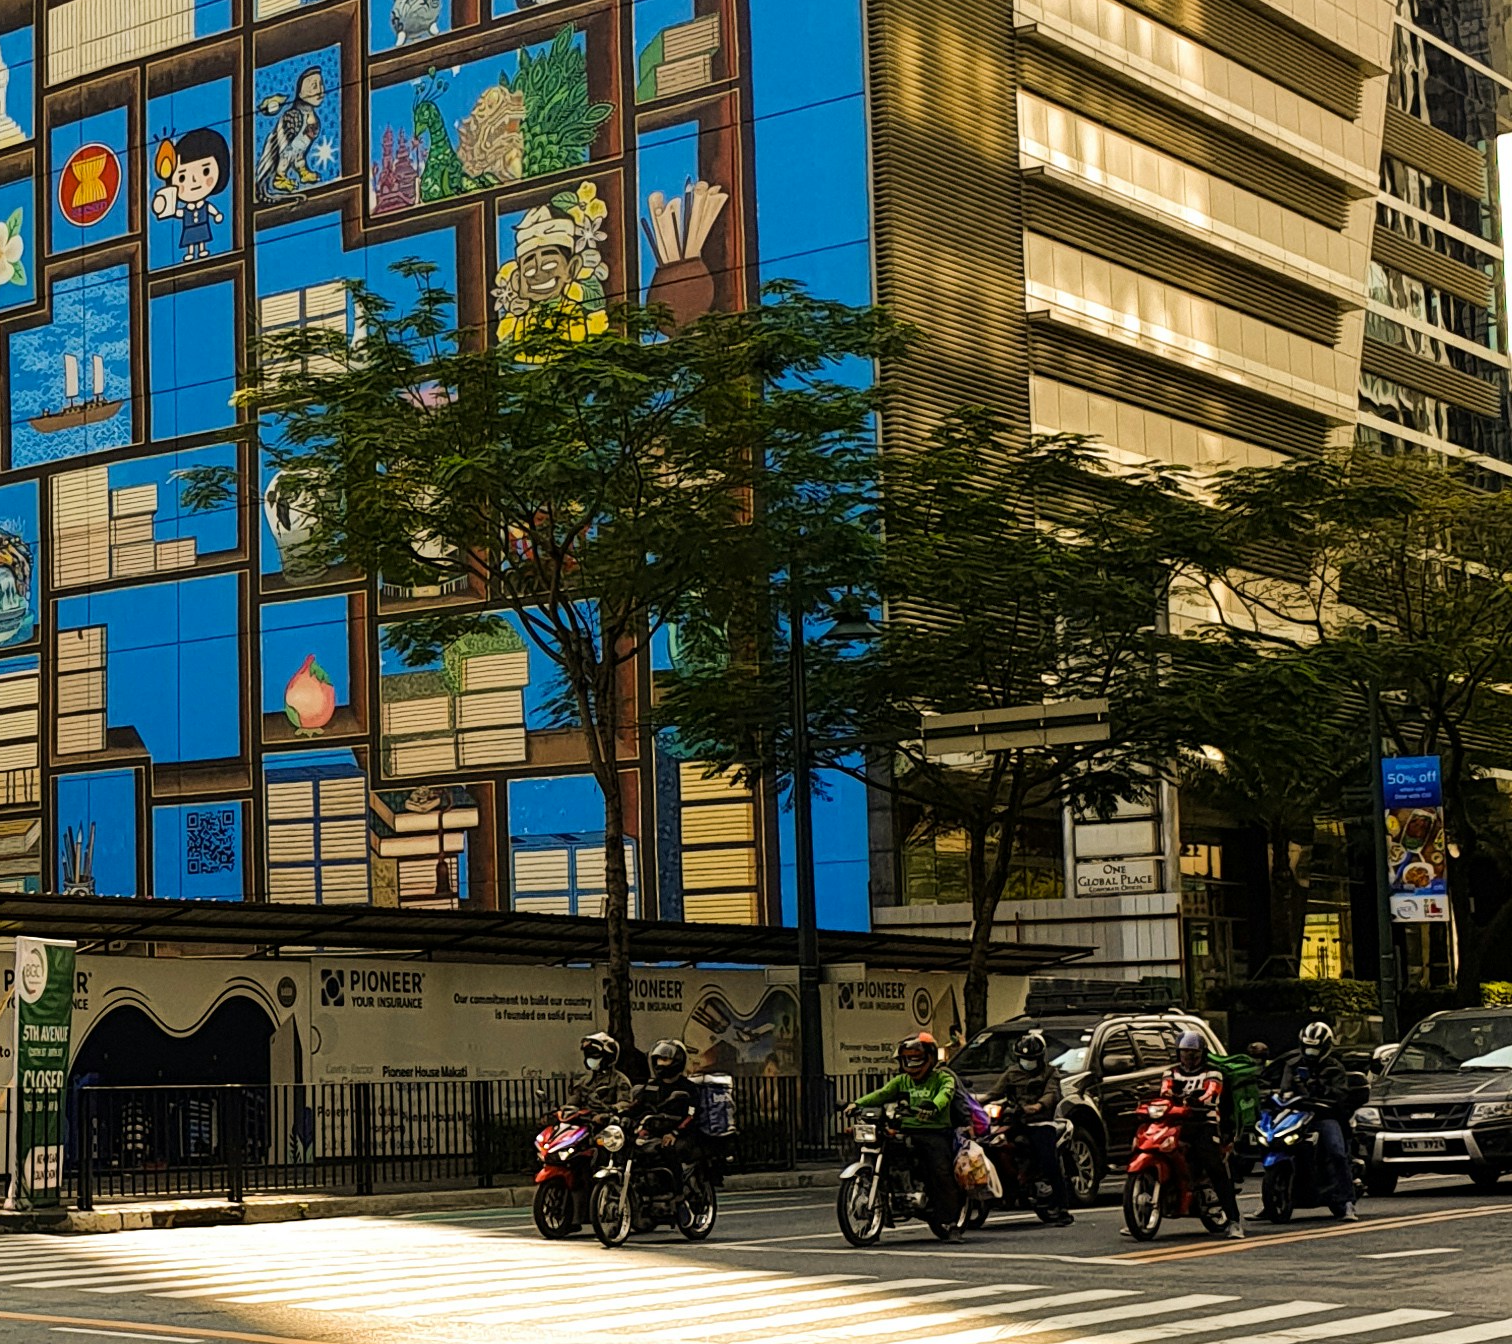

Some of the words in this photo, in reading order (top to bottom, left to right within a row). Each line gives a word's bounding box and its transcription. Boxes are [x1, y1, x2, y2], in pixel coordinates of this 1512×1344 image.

[1387, 773, 1416, 785] 50%
[1419, 770, 1437, 783] off
[350, 970, 423, 994] PIONEER
[857, 981, 905, 999] PIONEER
[351, 996, 375, 1008] YOUR
[376, 996, 423, 1009] INSURANCE
[453, 992, 468, 1004] Our
[520, 994, 529, 1005] to
[529, 994, 549, 1006] build
[563, 996, 592, 1009] country
[631, 1001, 646, 1012] OUR
[494, 1008, 502, 1020] is
[503, 1008, 535, 1021] founded
[23, 1025, 40, 1041] 5TH
[40, 1025, 69, 1042] AVENUE
[0, 1045, 11, 1058] to
[382, 1065, 414, 1078] Pioneer
[414, 1065, 440, 1078] House
[440, 1065, 468, 1078] Makati
[22, 1069, 64, 1094] CLOSED
